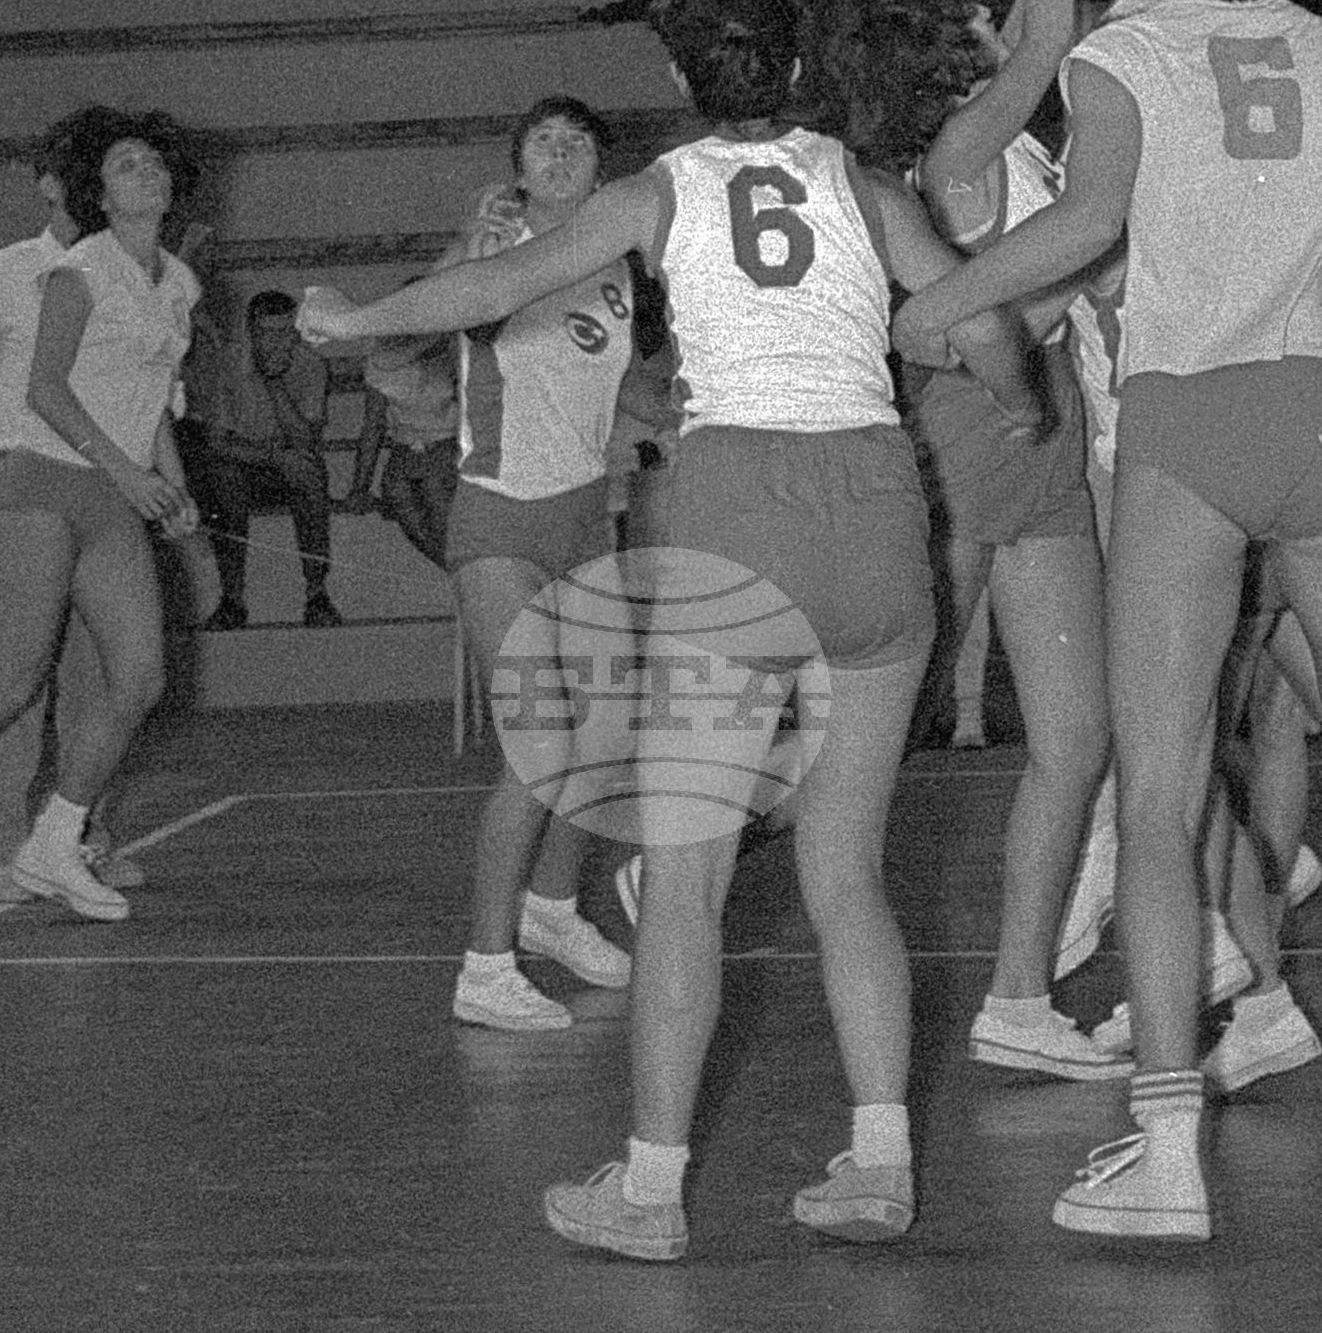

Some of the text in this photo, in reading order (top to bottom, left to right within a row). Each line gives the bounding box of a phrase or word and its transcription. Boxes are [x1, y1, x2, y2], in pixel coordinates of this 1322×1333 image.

[1207, 36, 1303, 160] 6
[726, 164, 815, 287] 6
[601, 283, 629, 320] 8
